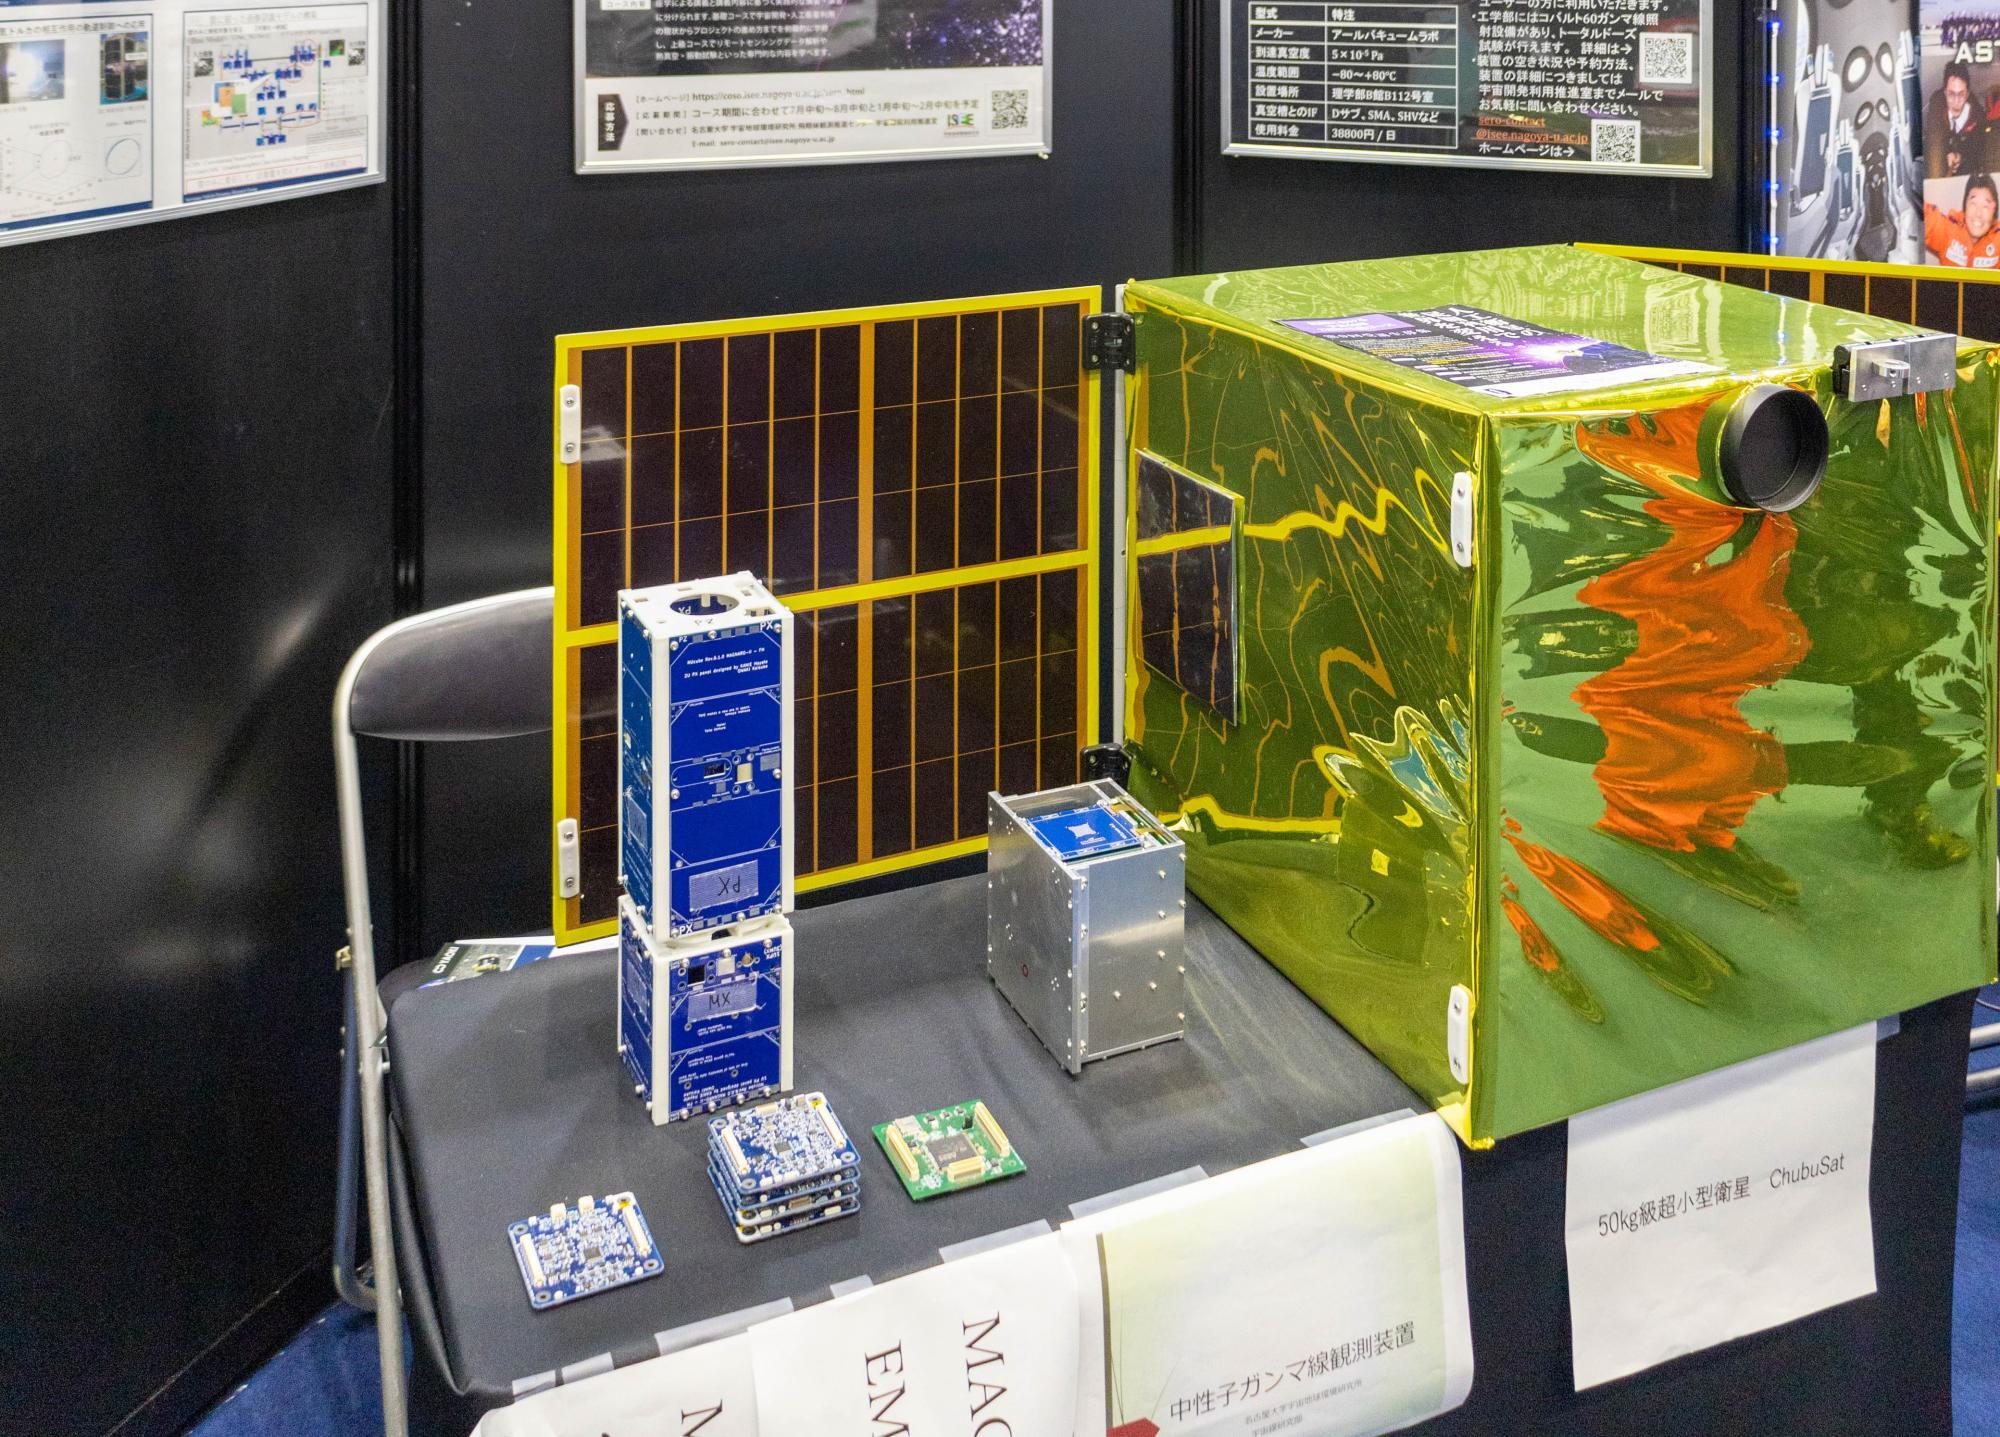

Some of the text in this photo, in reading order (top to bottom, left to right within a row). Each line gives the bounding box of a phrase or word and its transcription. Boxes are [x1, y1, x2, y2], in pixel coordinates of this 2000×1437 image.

[1255, 7, 1278, 20] 型式
[1331, 8, 1355, 21] 特注
[1255, 27, 1294, 38] メーカー
[1479, 25, 1637, 39] 射設備があり、トータルドーズ
[1255, 46, 1310, 60] 到達真空度
[1479, 39, 1570, 54] 試験が行えます。
[1955, 40, 2000, 64] AS
[1255, 66, 1299, 78] 温度範囲
[1479, 71, 1623, 85] 装置の詳細につきましては
[1255, 85, 1299, 98] 設置場所
[1331, 87, 1434, 103] 理学部B館B112号室
[1479, 84, 1664, 102] 宇宙開発利用推進室までメールで
[1479, 99, 1639, 116] お気軽に問い合わせください。
[1255, 124, 1299, 137] 使用料金
[1479, 143, 1562, 157] ホームページは
[760, 620, 773, 631] PX
[679, 923, 693, 935] PX
[1599, 1152, 1845, 1236] 50kg級超小型衛星 ChubuSat
[1170, 1320, 1415, 1422] 中性子ガンマ線観測装置
